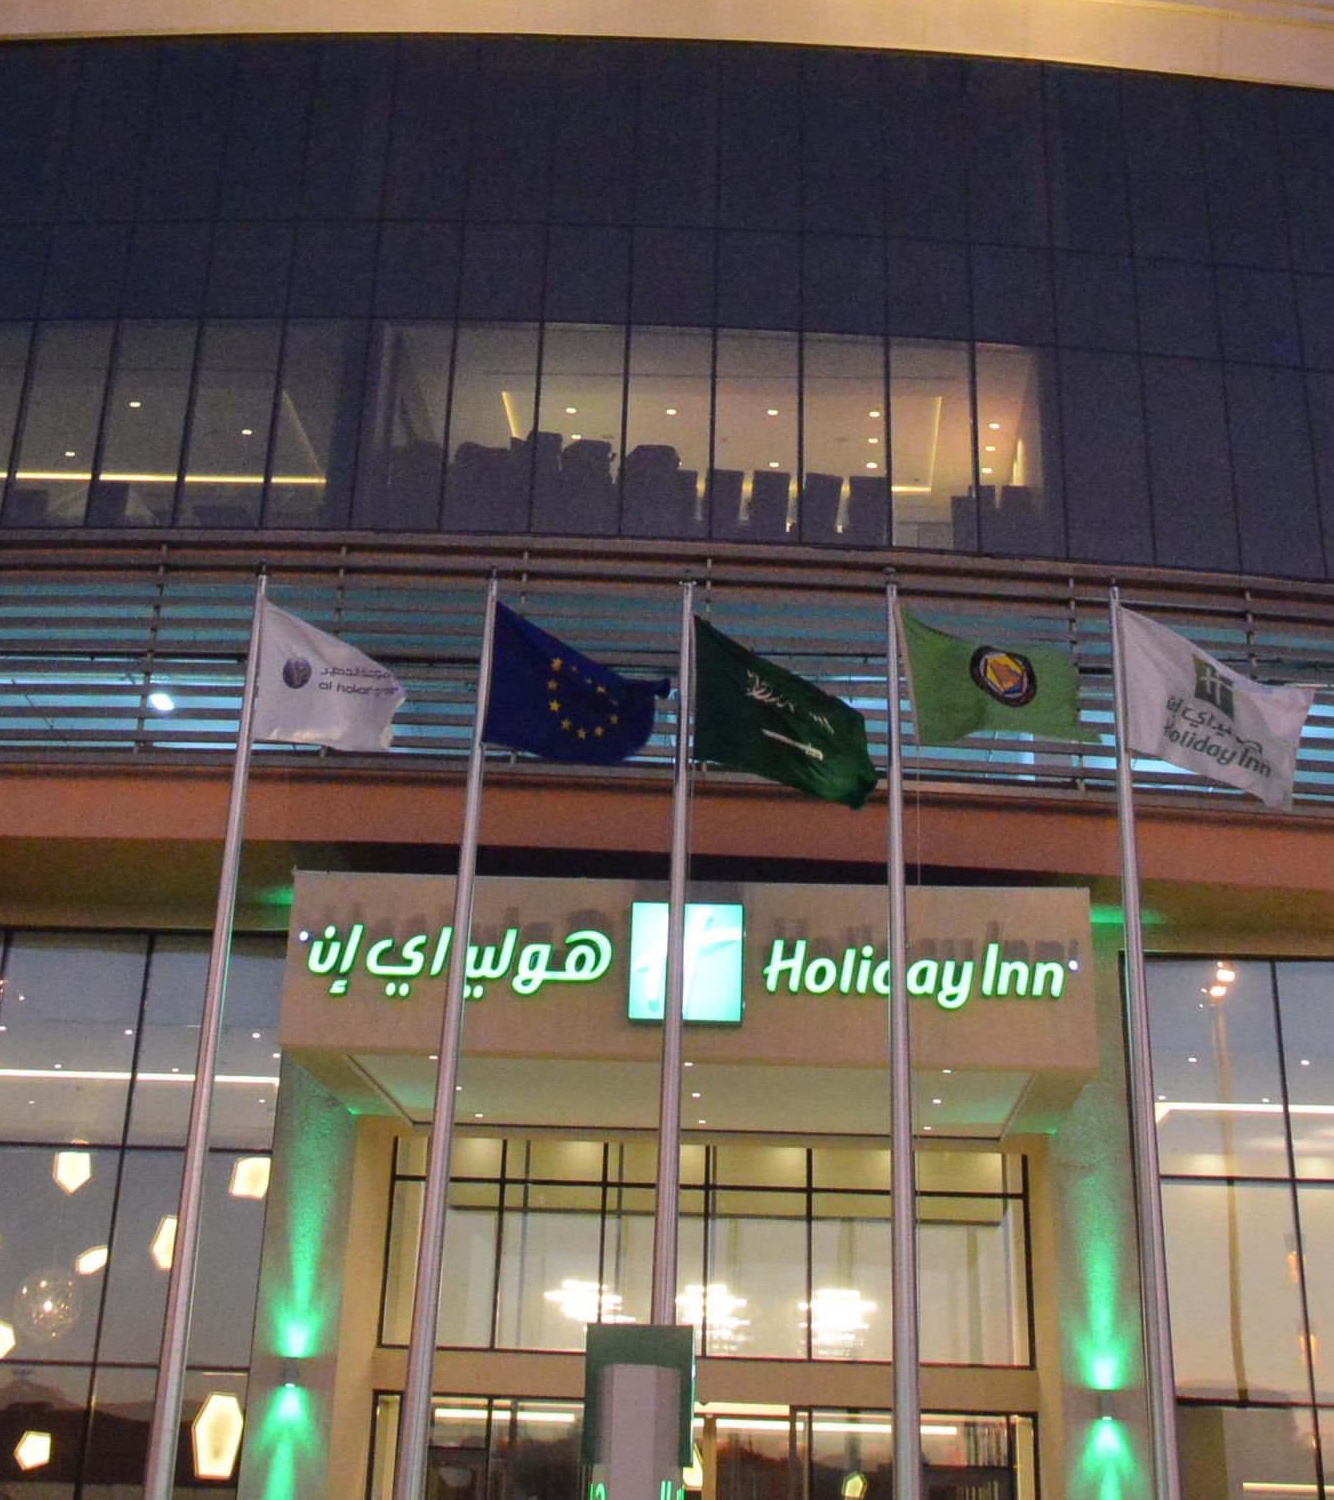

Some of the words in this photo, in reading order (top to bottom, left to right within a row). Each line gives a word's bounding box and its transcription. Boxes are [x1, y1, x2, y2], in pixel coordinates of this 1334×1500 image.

[1237, 747, 1272, 778] Inn
[307, 924, 364, 994] إن
[981, 943, 1065, 998] Inn
